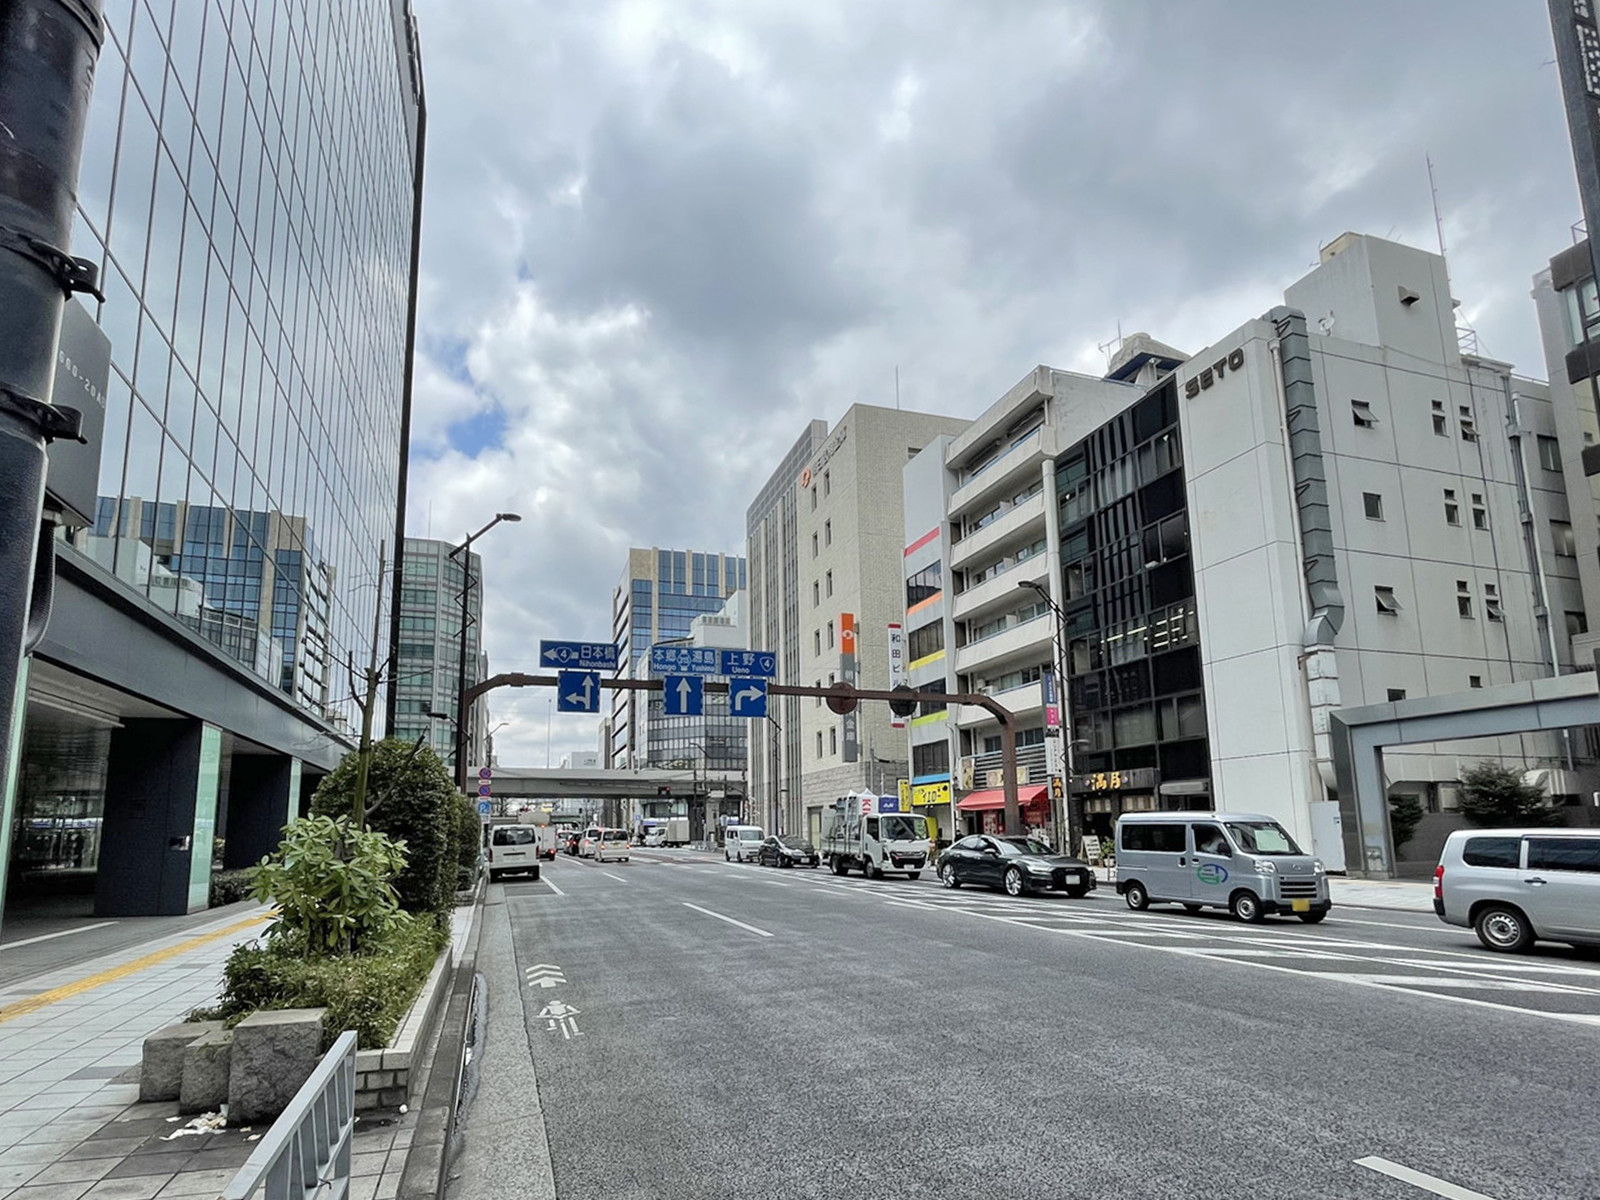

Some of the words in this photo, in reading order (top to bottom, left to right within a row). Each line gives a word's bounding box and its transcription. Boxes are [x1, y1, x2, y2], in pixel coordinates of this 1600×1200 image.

[1185, 347, 1244, 400] SETO
[561, 650, 567, 658] 4
[581, 645, 615, 659] 日本橋
[654, 649, 677, 662] 本郷
[579, 659, 616, 668] Nihonbashi
[727, 653, 755, 665] 上野
[764, 660, 770, 668] 4
[653, 663, 677, 671] Hongo
[1090, 771, 1121, 790] 満月
